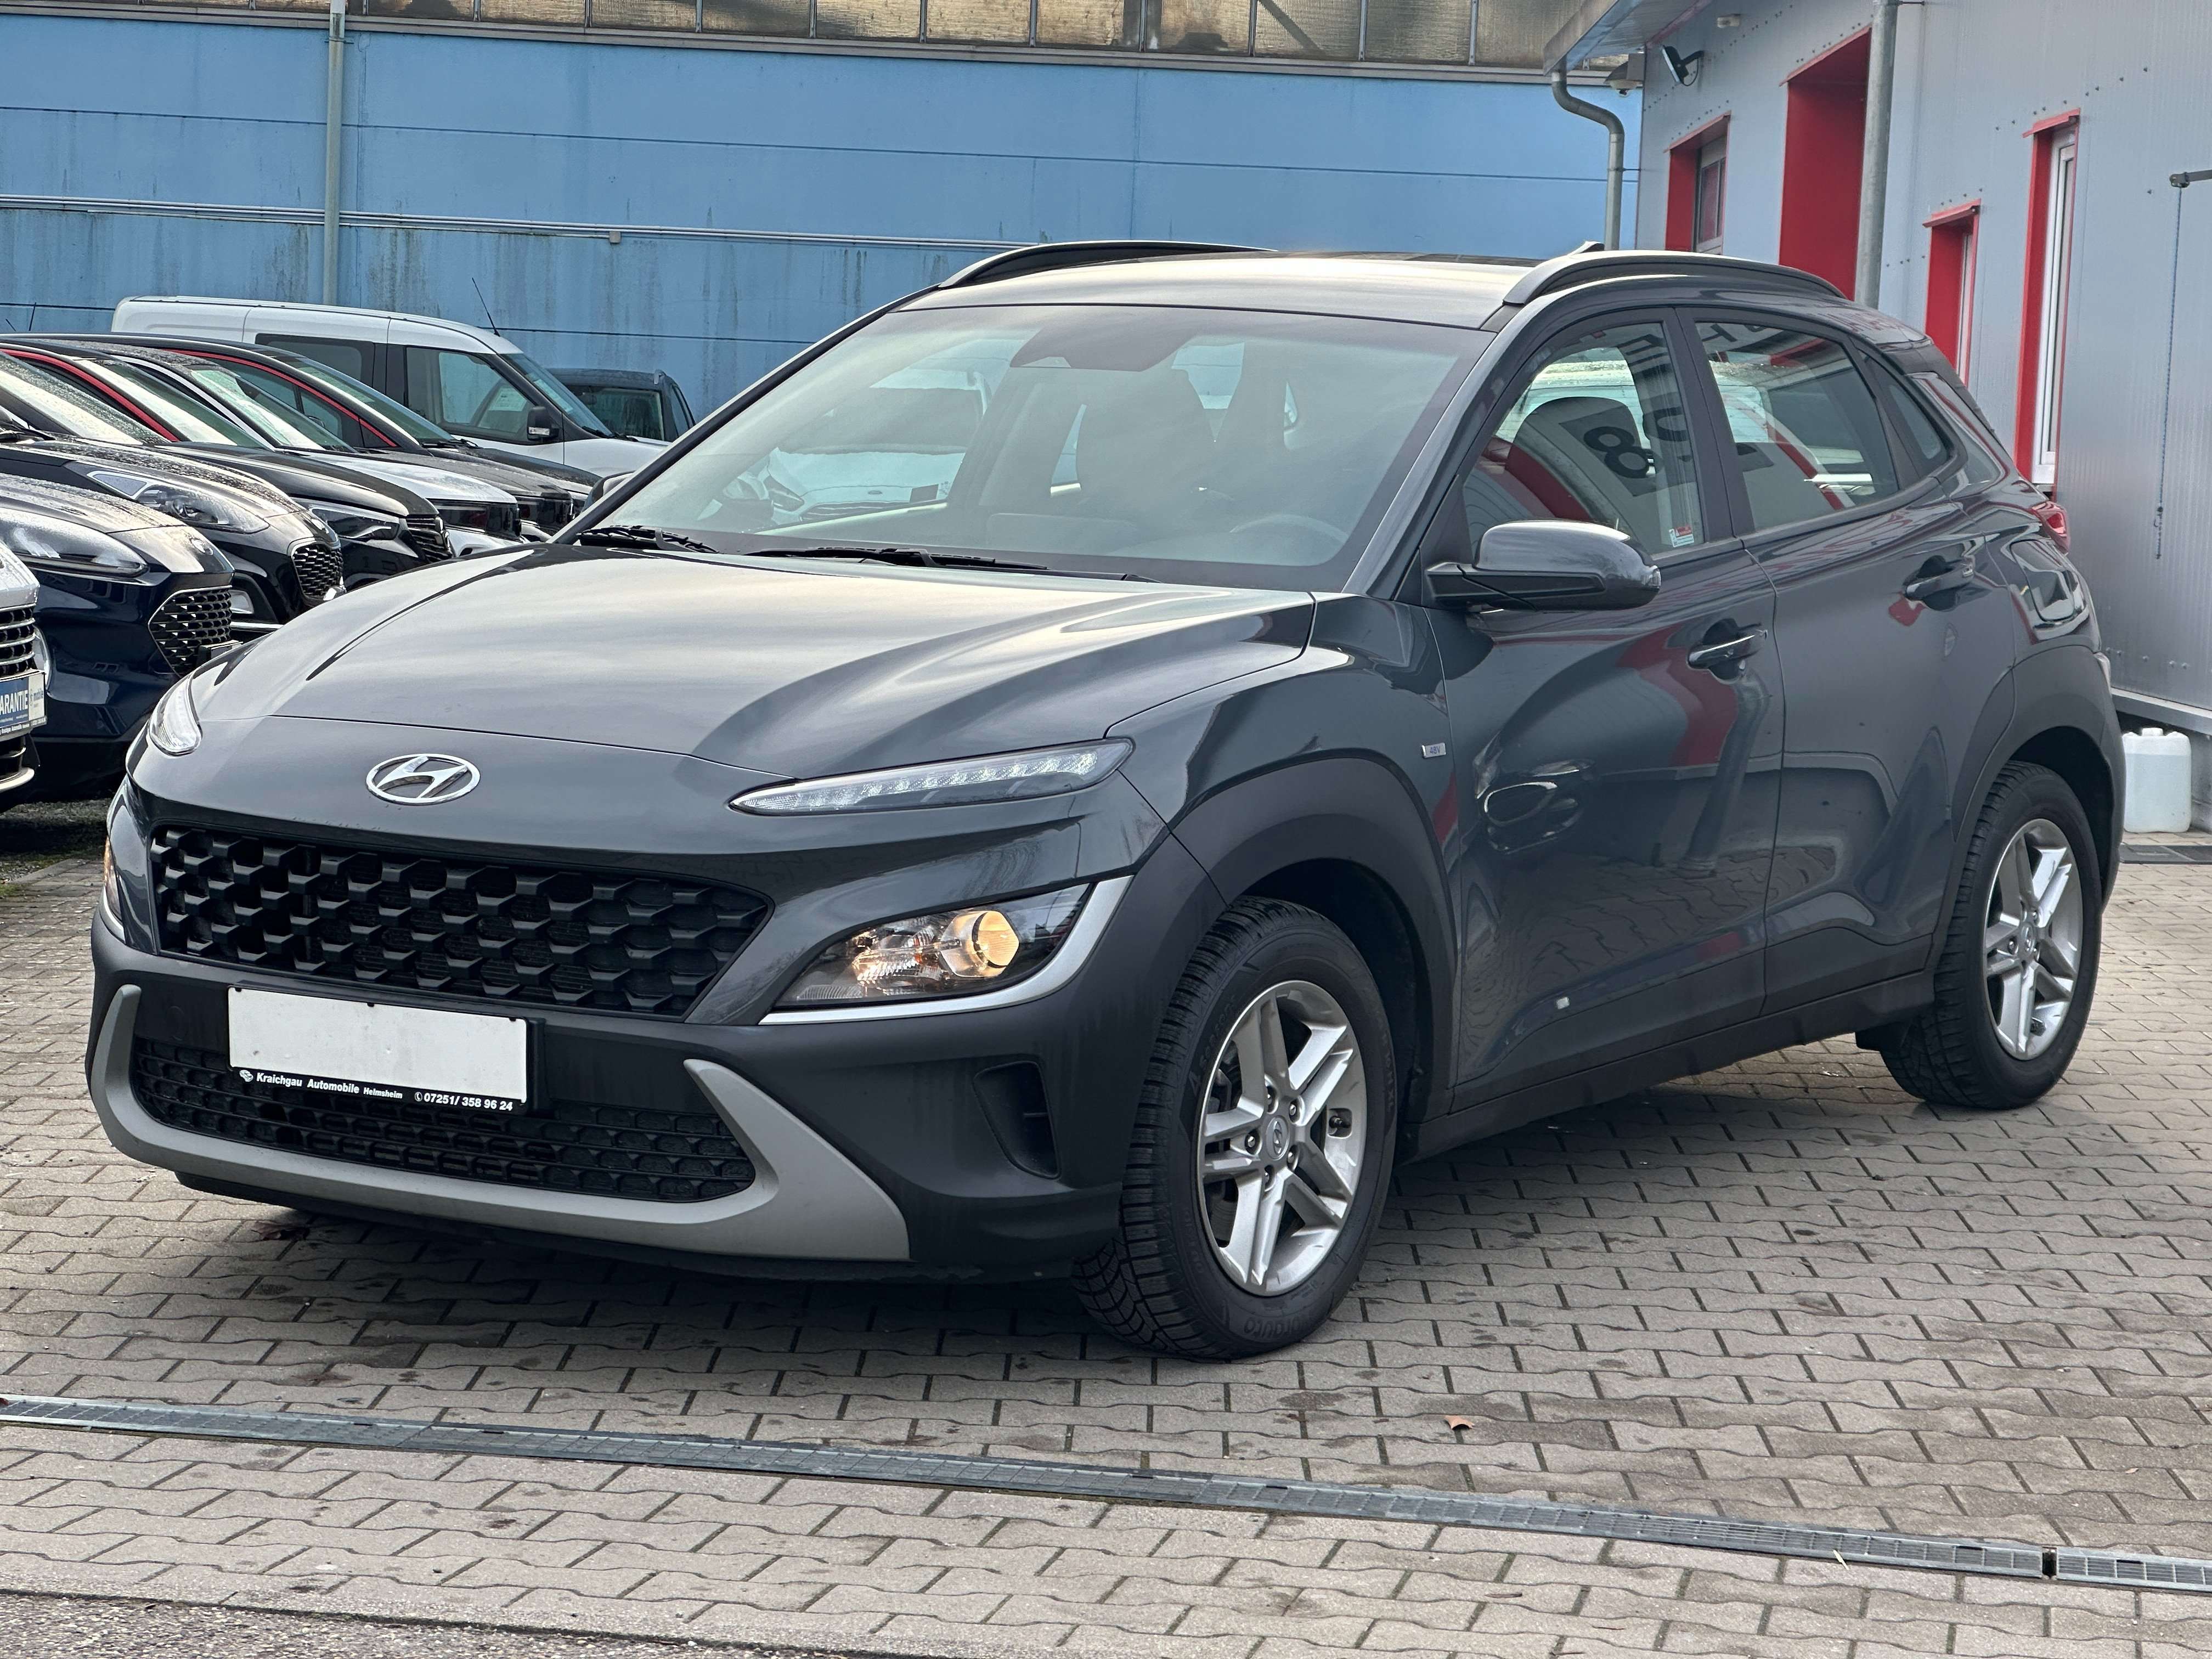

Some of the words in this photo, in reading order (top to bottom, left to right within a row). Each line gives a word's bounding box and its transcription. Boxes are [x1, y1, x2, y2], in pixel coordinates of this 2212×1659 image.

[256, 1072, 302, 1087] Kraichgau
[307, 1079, 360, 1094] Automobile
[363, 1087, 403, 1099] Helmsheim
[424, 1092, 460, 1105] 07251/
[461, 1097, 481, 1108] 358
[484, 1099, 498, 1109] 96
[499, 1101, 514, 1111] 24
